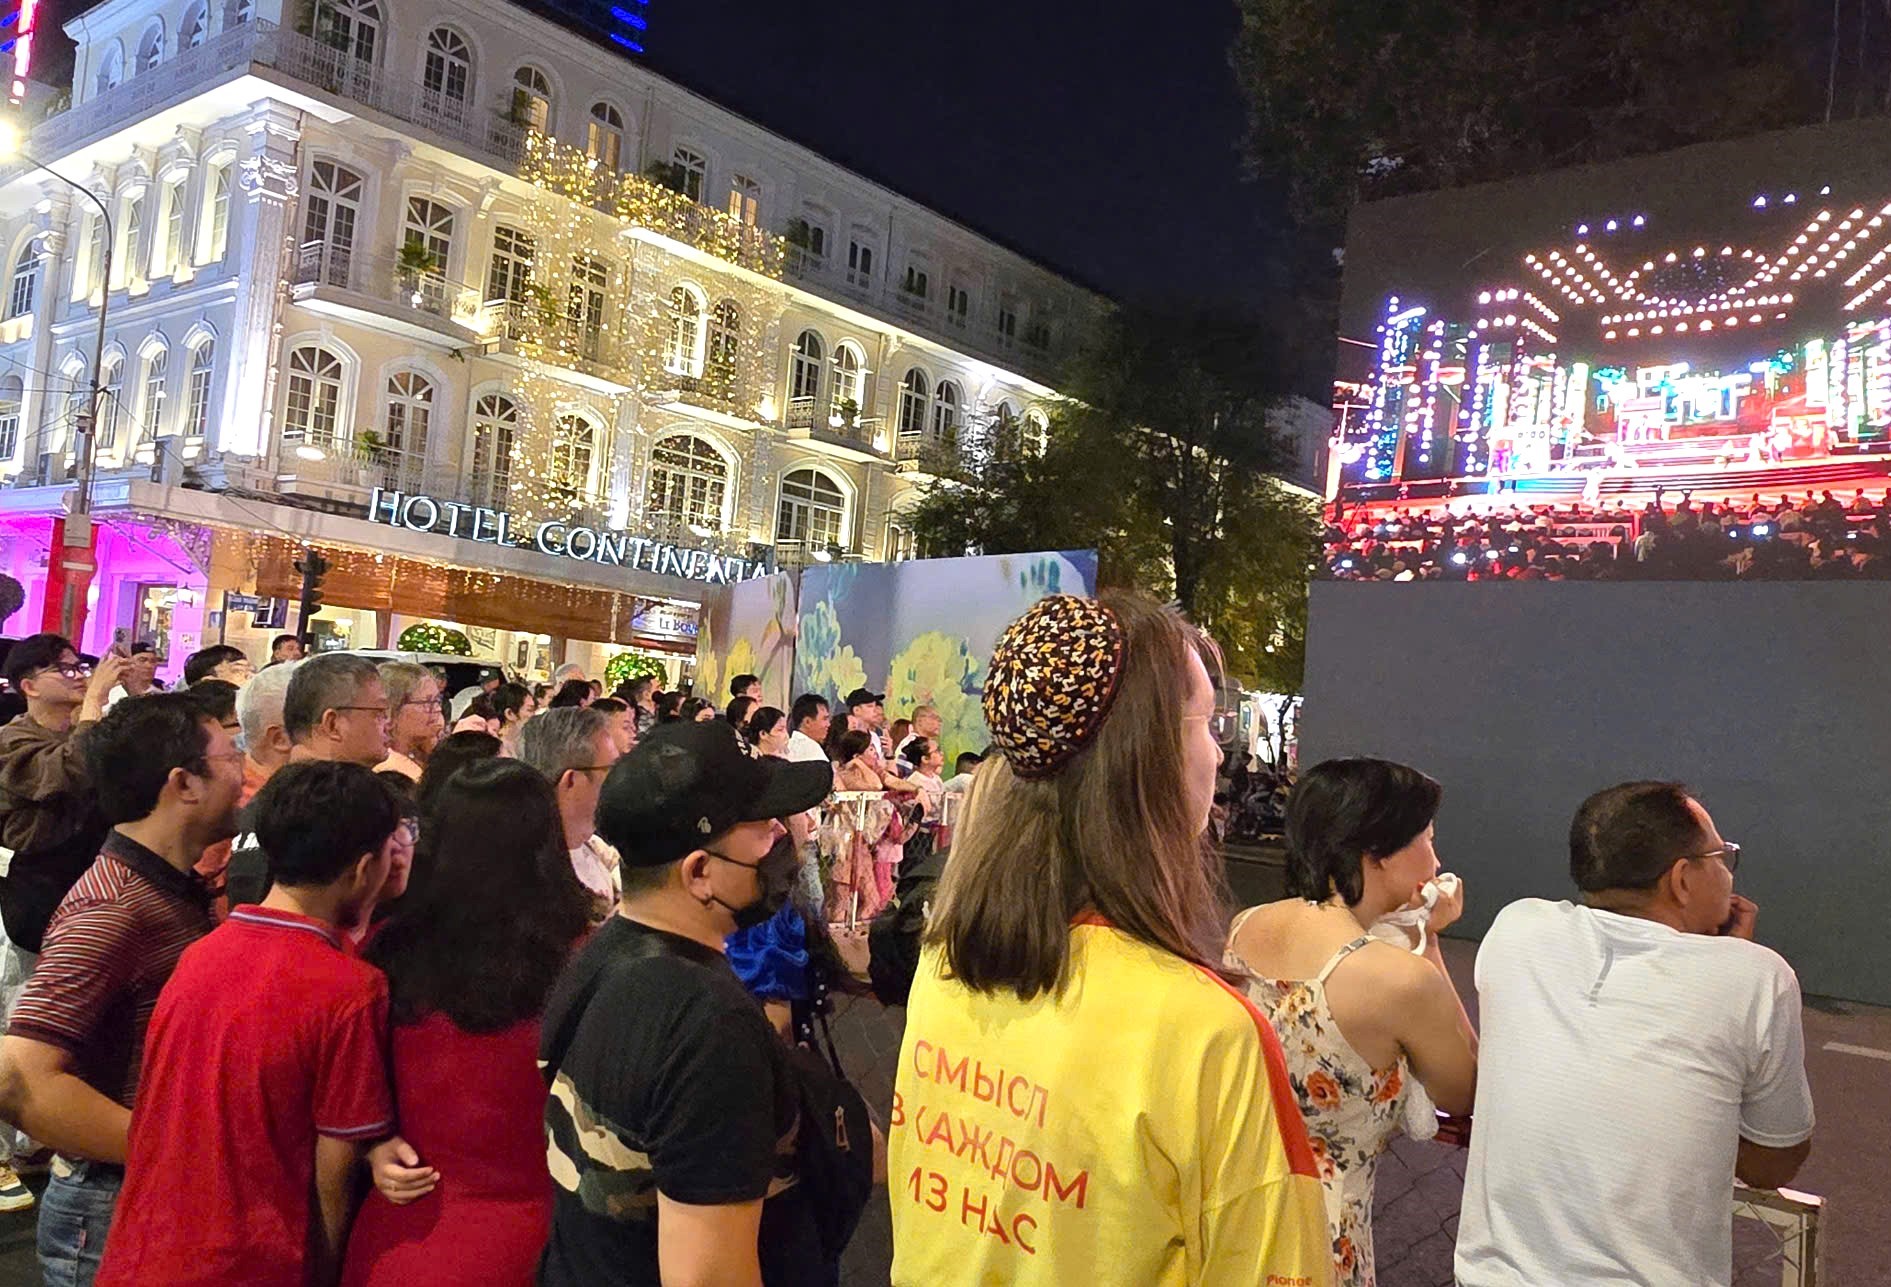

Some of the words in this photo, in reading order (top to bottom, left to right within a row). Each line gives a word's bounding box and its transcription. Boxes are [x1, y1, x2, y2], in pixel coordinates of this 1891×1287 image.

[369, 487, 517, 547] HOTEL
[914, 1039, 1049, 1129] СМЫСЛ
[961, 1187, 1038, 1254] НАС
